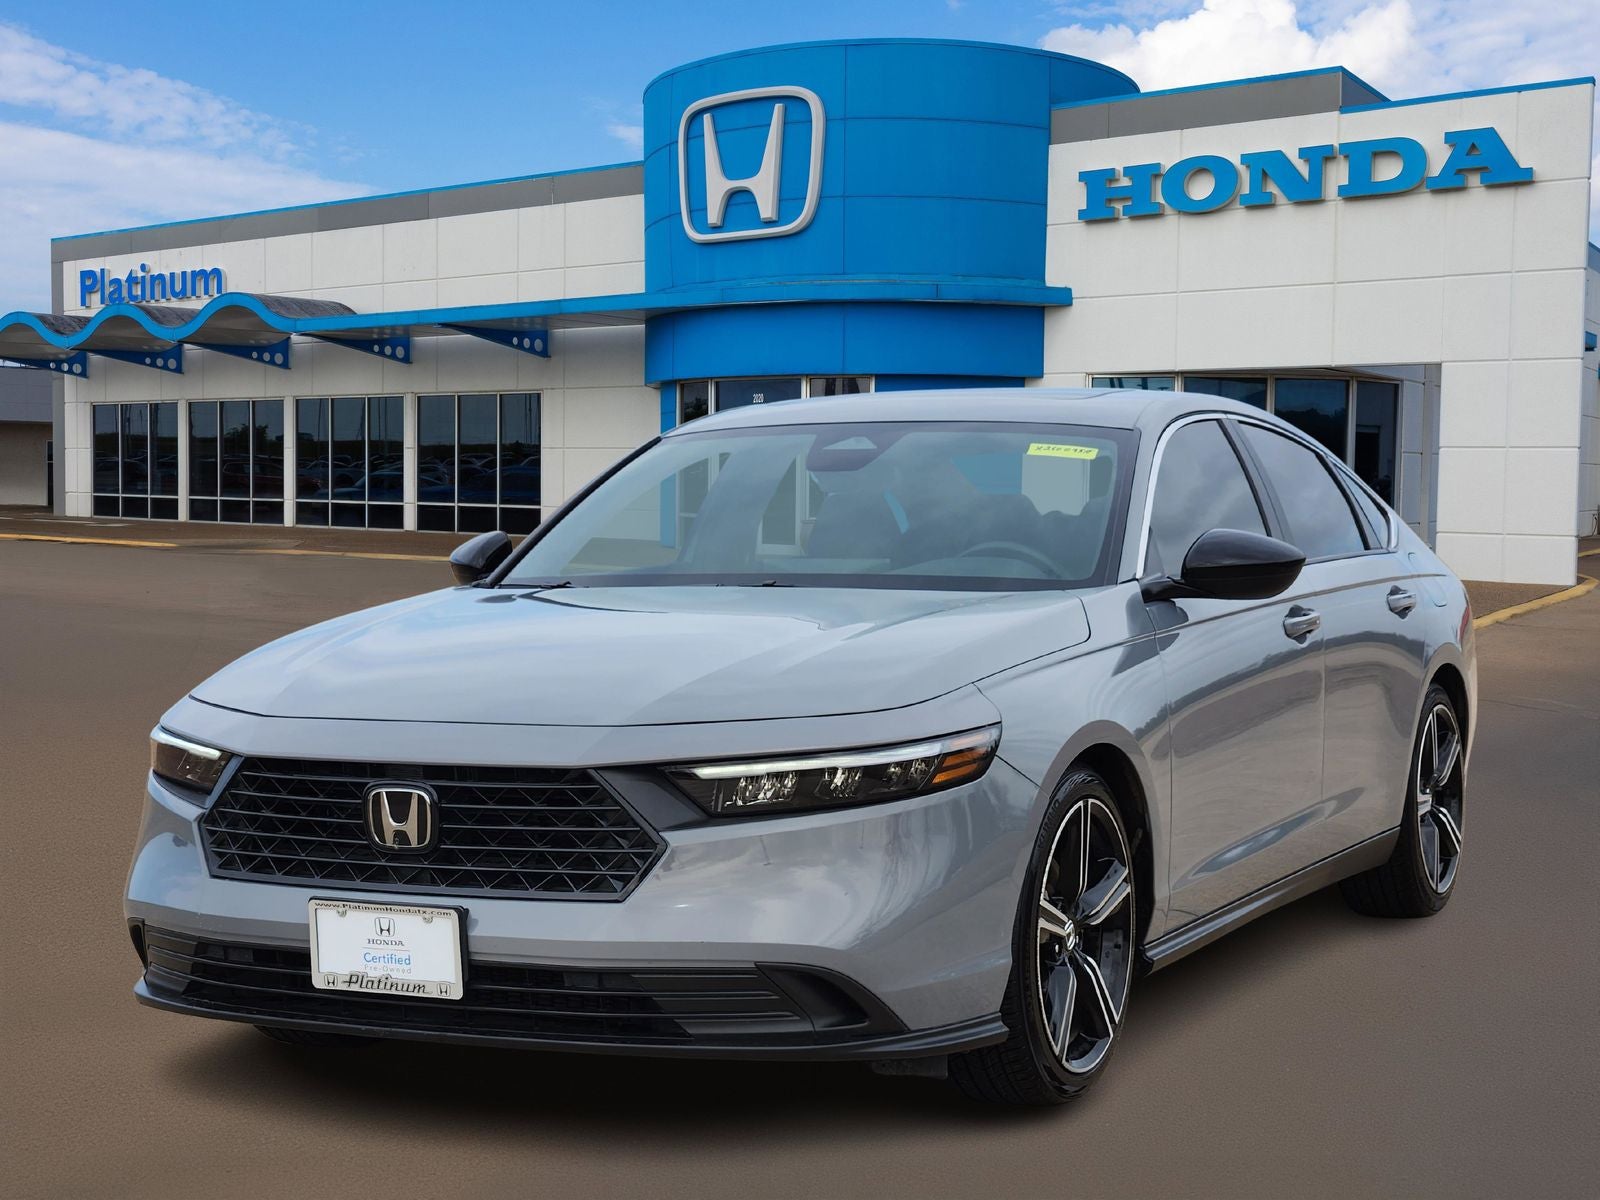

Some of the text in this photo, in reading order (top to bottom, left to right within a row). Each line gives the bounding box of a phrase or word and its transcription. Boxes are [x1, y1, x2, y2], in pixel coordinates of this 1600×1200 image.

[1078, 126, 1534, 222] HONDA
[80, 263, 224, 307] Platinum
[367, 938, 405, 947] HONDA
[363, 952, 411, 966] Certified
[364, 965, 412, 975] Pre-Owned
[342, 974, 433, 995] Platinum
